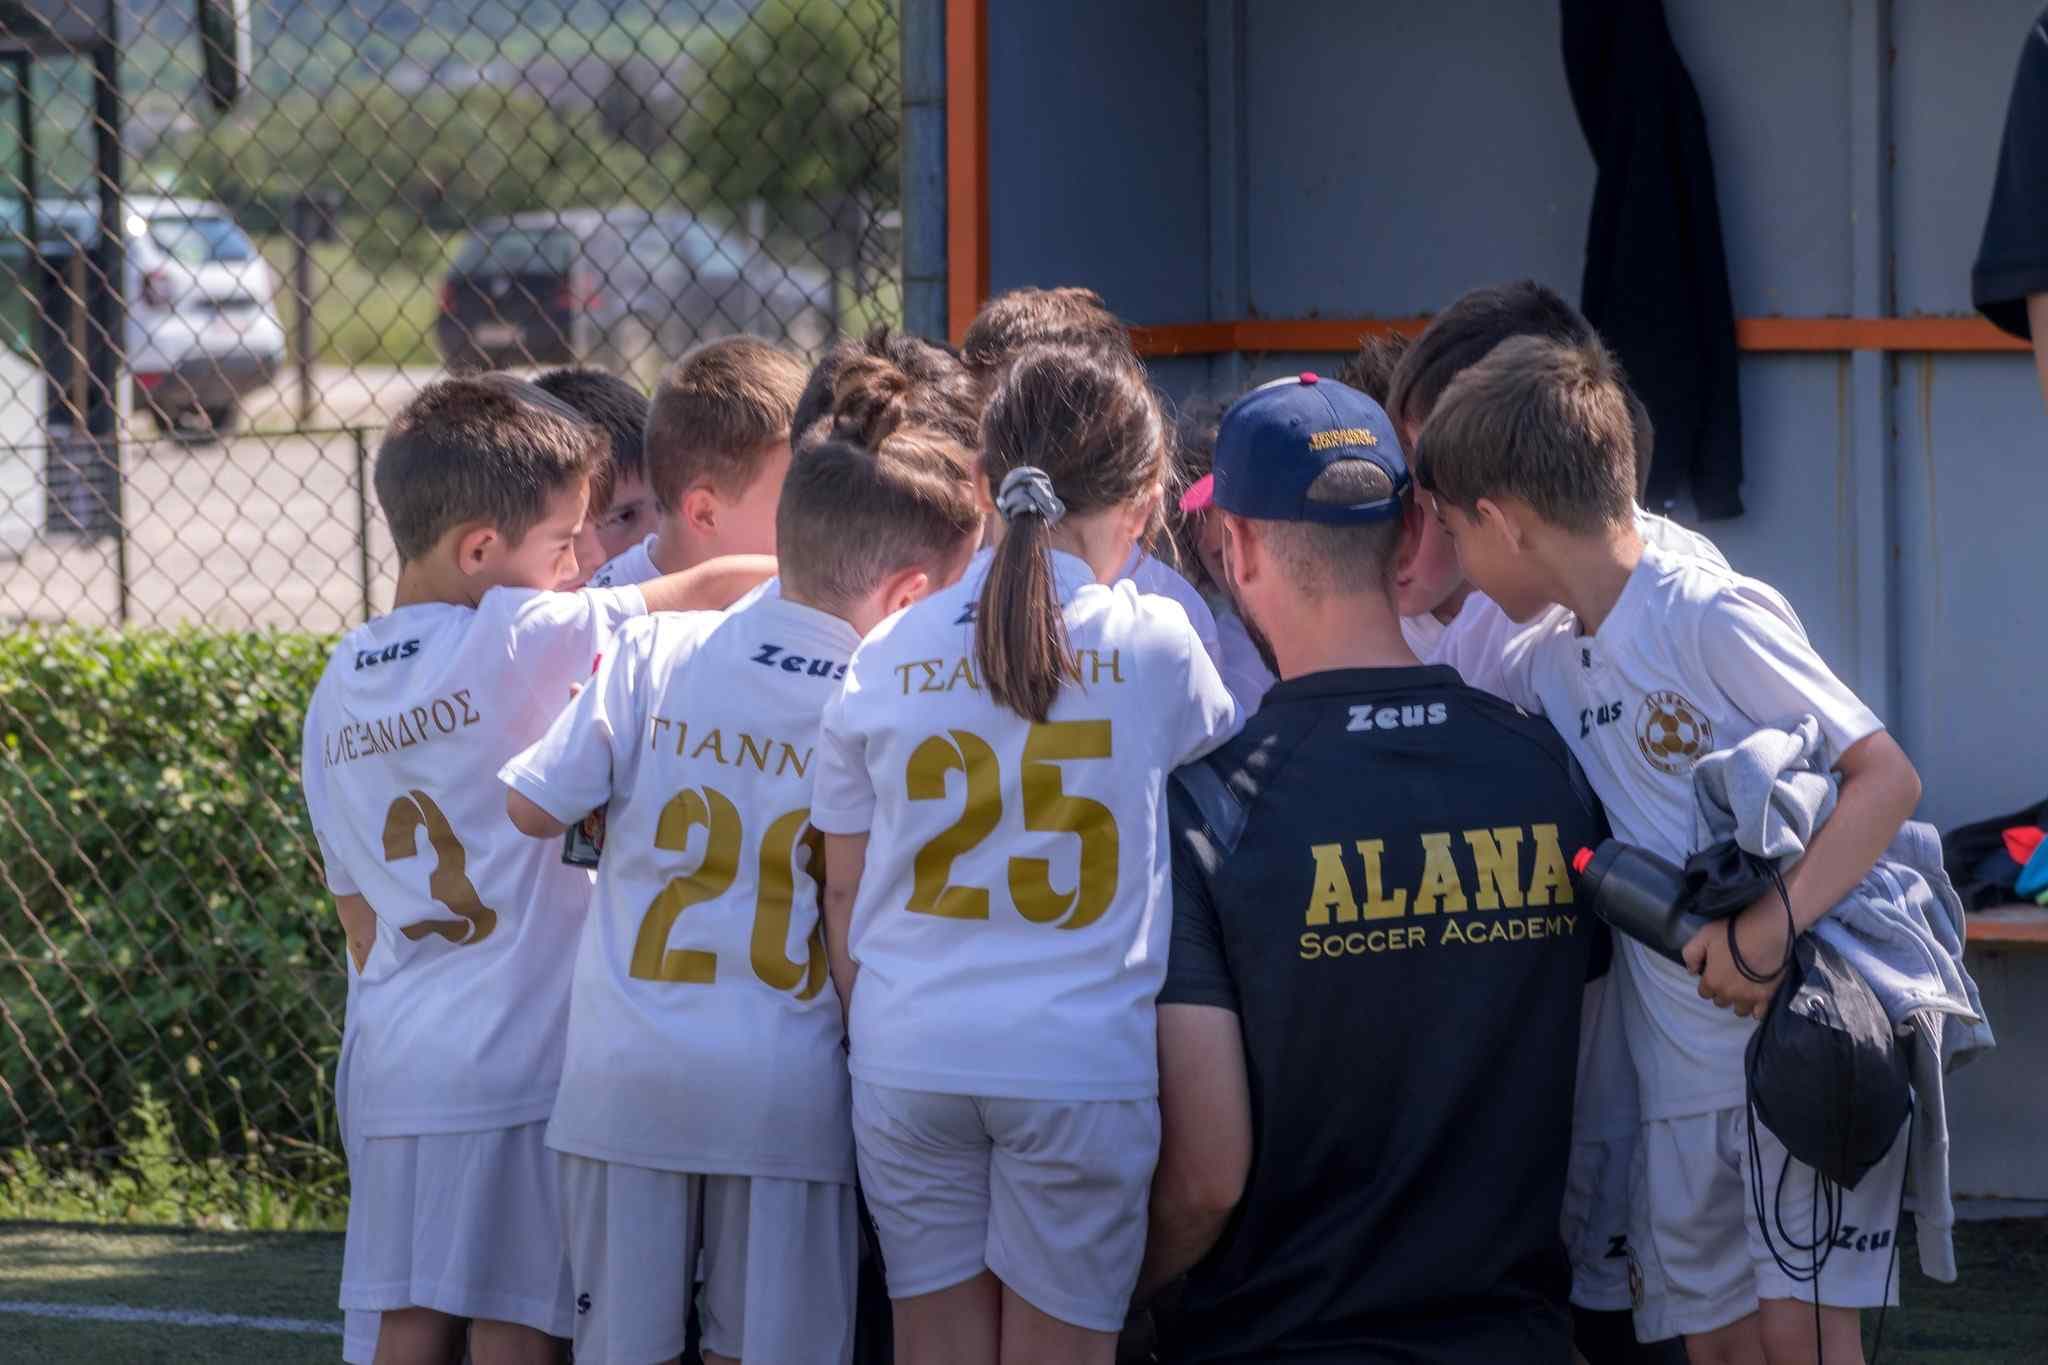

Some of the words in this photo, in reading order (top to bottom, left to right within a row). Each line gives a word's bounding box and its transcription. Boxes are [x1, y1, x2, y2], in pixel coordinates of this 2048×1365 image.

[750, 644, 848, 680] Zeus
[651, 715, 815, 778] ΓΙΑΝΝ
[1346, 701, 1448, 731] Zeus
[904, 719, 1120, 930] 25
[629, 785, 830, 1001] 20
[1305, 823, 1575, 926] ALANA
